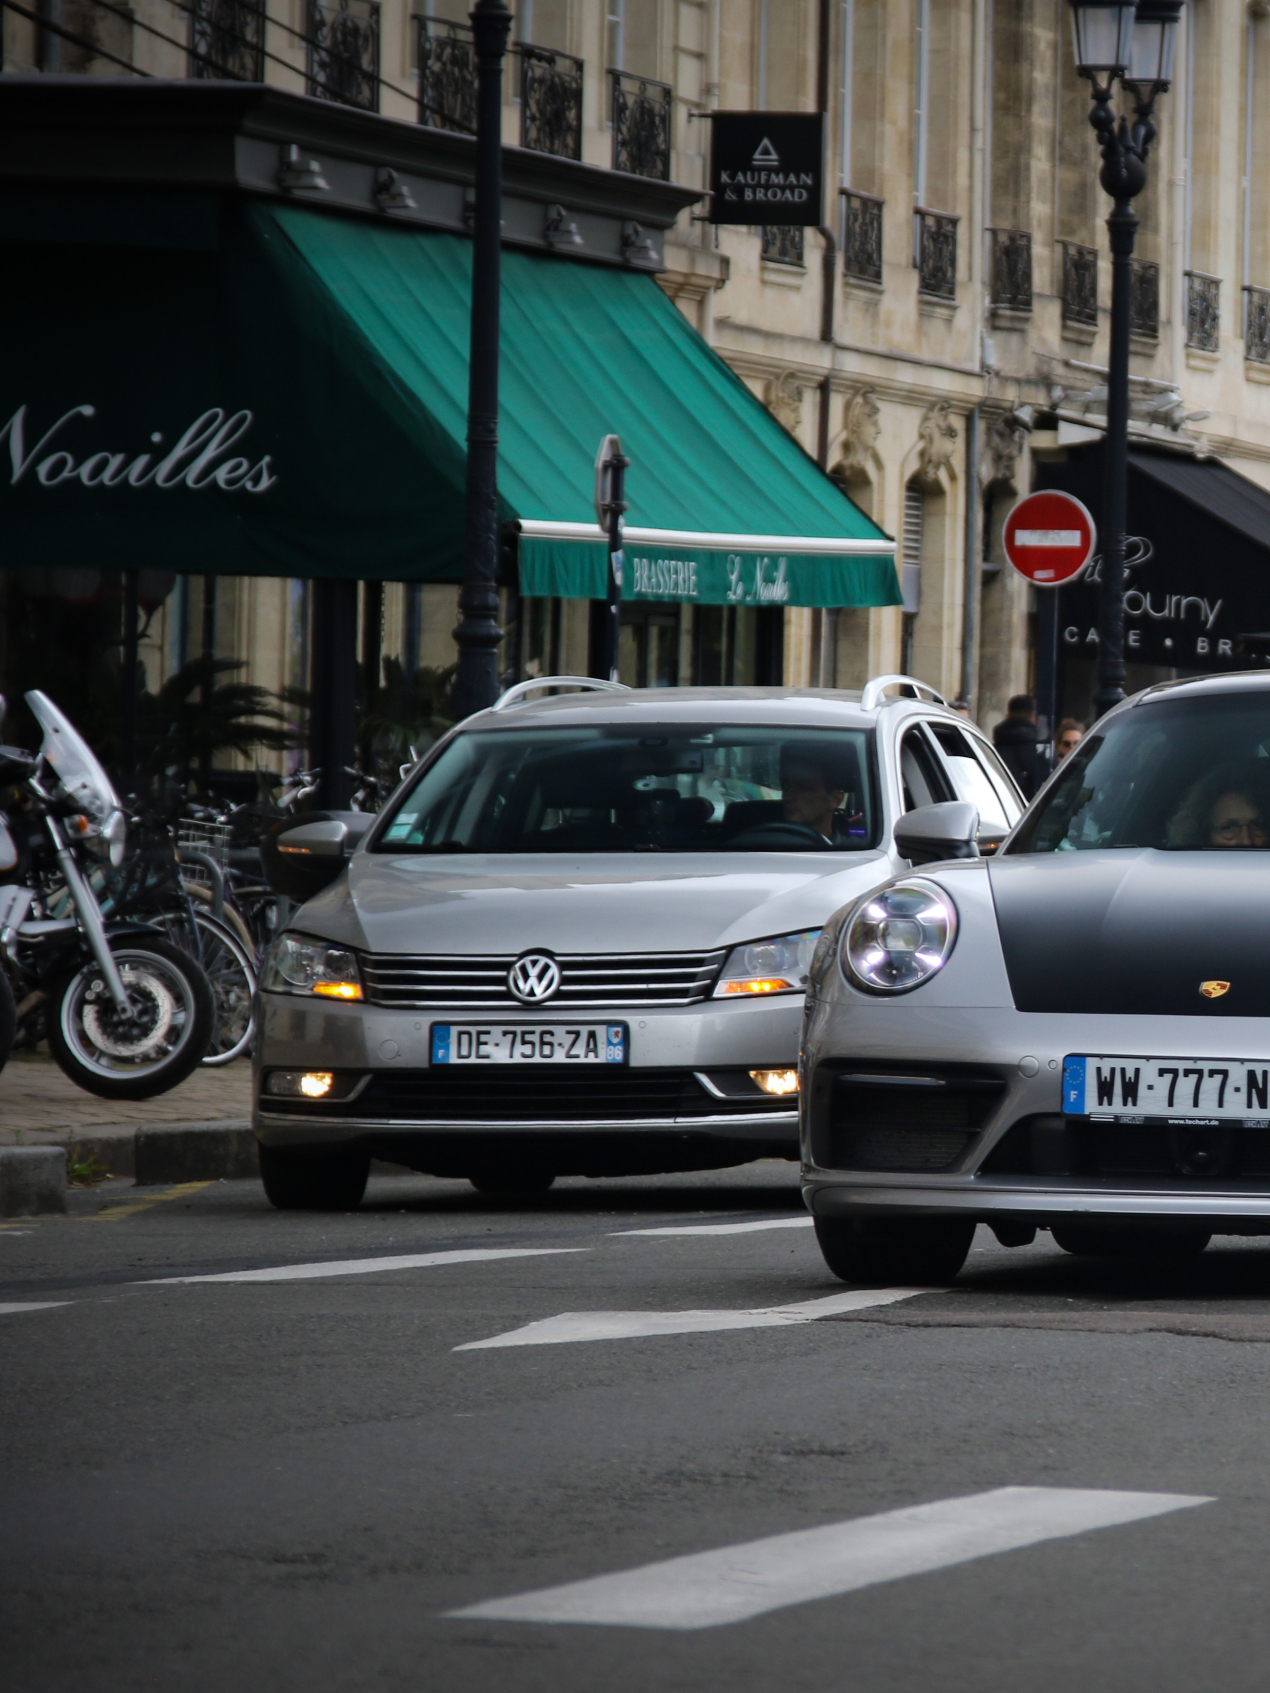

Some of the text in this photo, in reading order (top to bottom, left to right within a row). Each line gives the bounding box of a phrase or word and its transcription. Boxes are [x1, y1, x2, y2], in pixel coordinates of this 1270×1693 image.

[720, 170, 813, 185] KAUFMAN
[724, 186, 808, 201] & BROAD
[0, 403, 277, 492] Noailles
[633, 557, 698, 595] BRASSERIE
[1122, 590, 1223, 630] ourny
[1064, 625, 1141, 647] CAE
[437, 1049, 445, 1059] F
[606, 1045, 623, 1060] 86
[1069, 1091, 1079, 1102] F
[1168, 1118, 1220, 1127] www.techart.de
